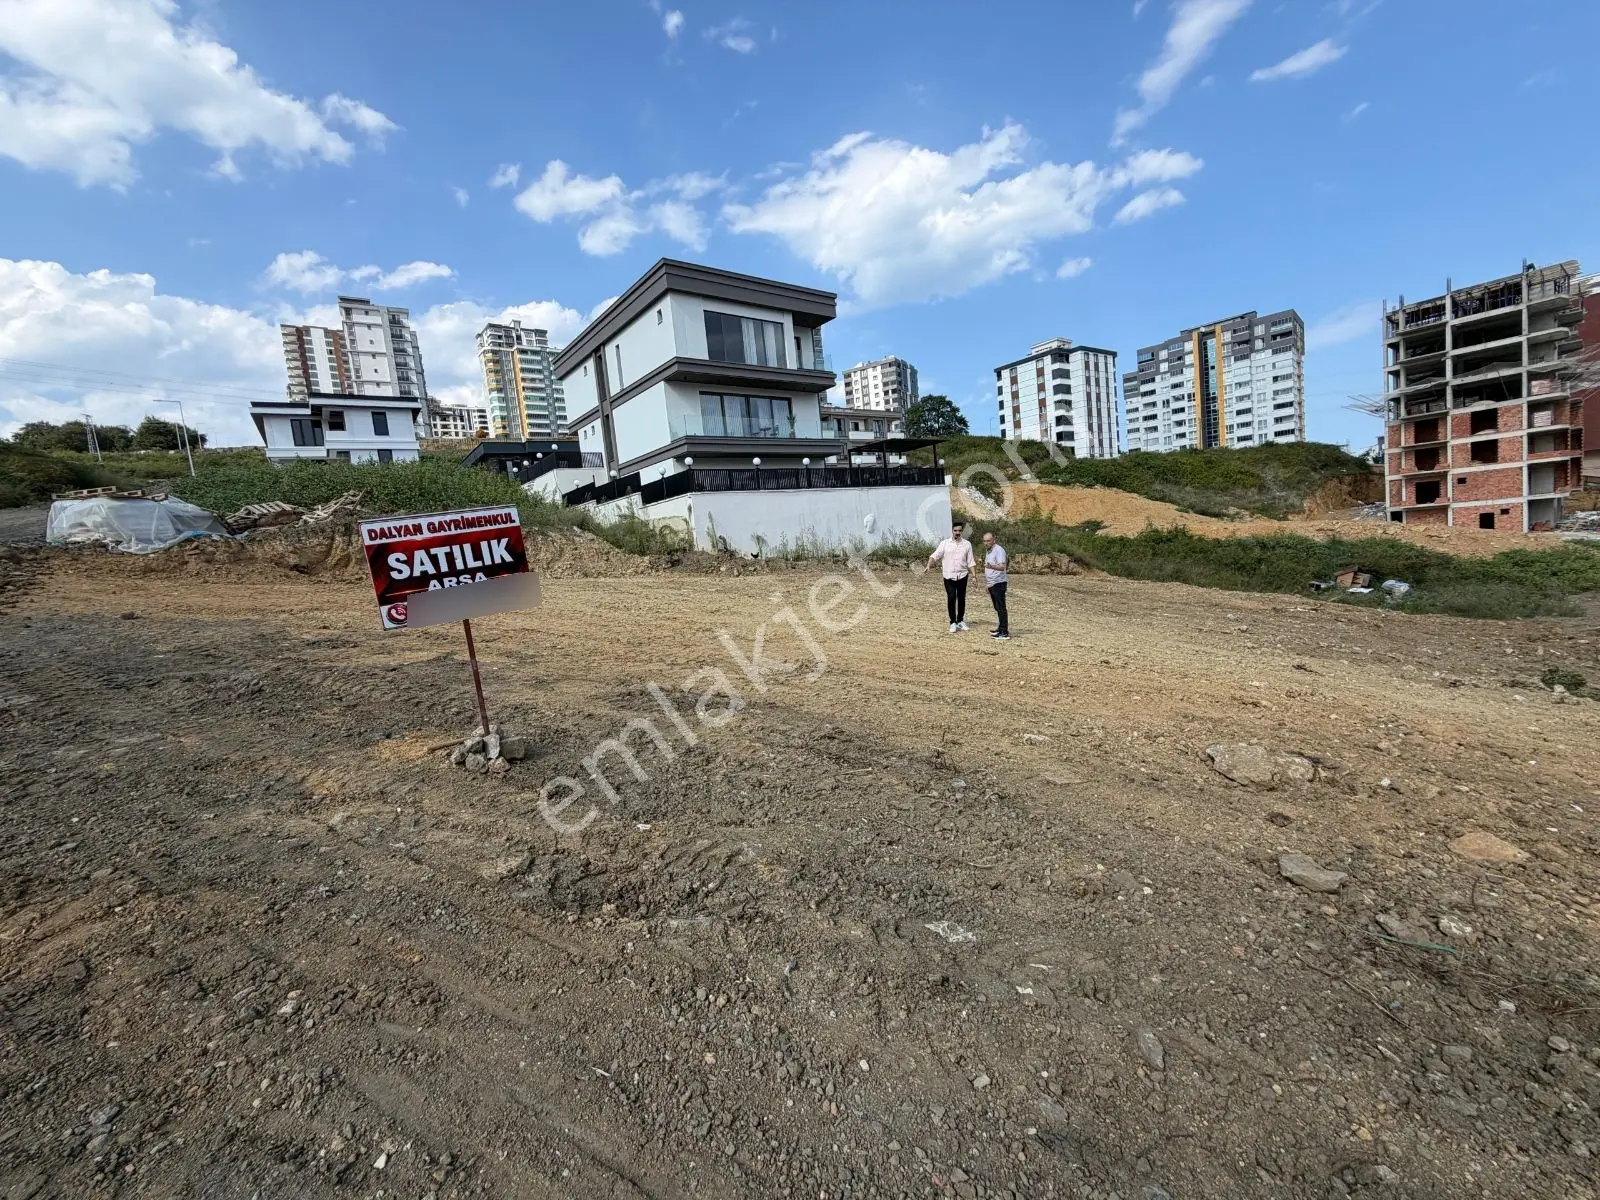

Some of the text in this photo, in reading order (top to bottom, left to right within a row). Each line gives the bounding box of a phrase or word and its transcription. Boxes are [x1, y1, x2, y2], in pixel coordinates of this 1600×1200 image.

[367, 512, 516, 542] DALYAN GAYRİMENKUL
[387, 537, 515, 580] SATILIK
[428, 572, 488, 592] ARSA
